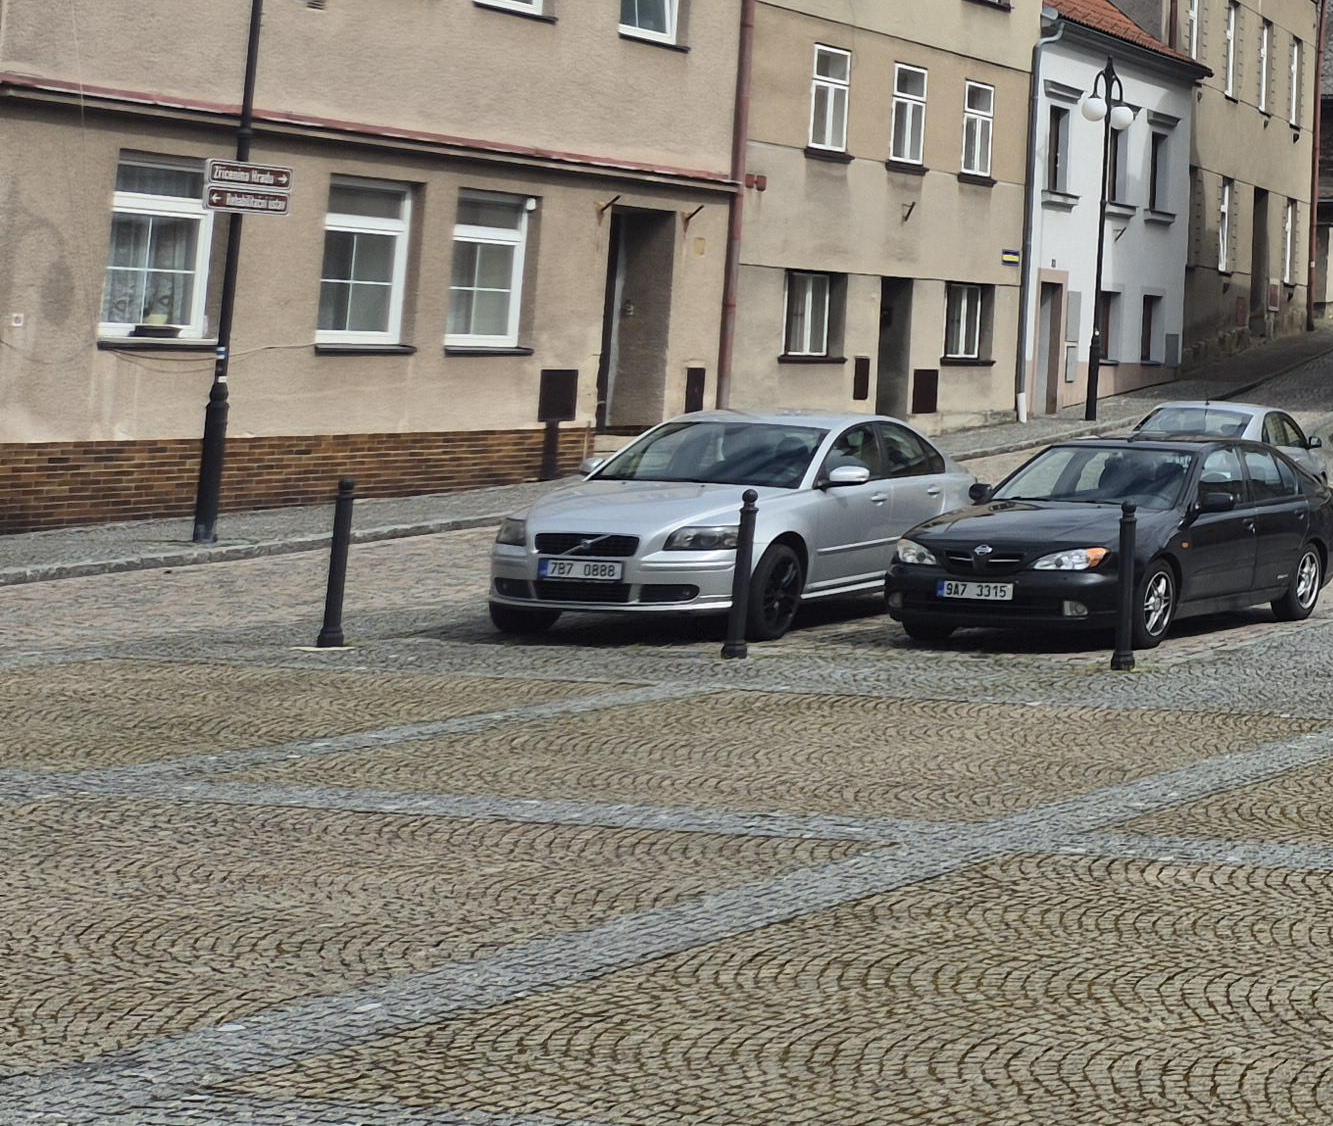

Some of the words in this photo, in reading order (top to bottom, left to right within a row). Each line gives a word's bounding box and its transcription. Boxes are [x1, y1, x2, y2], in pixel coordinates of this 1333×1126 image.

[551, 561, 574, 576] 7B7
[583, 564, 616, 578] 0888
[946, 582, 967, 596] 9A7
[976, 584, 1008, 598] 3315
